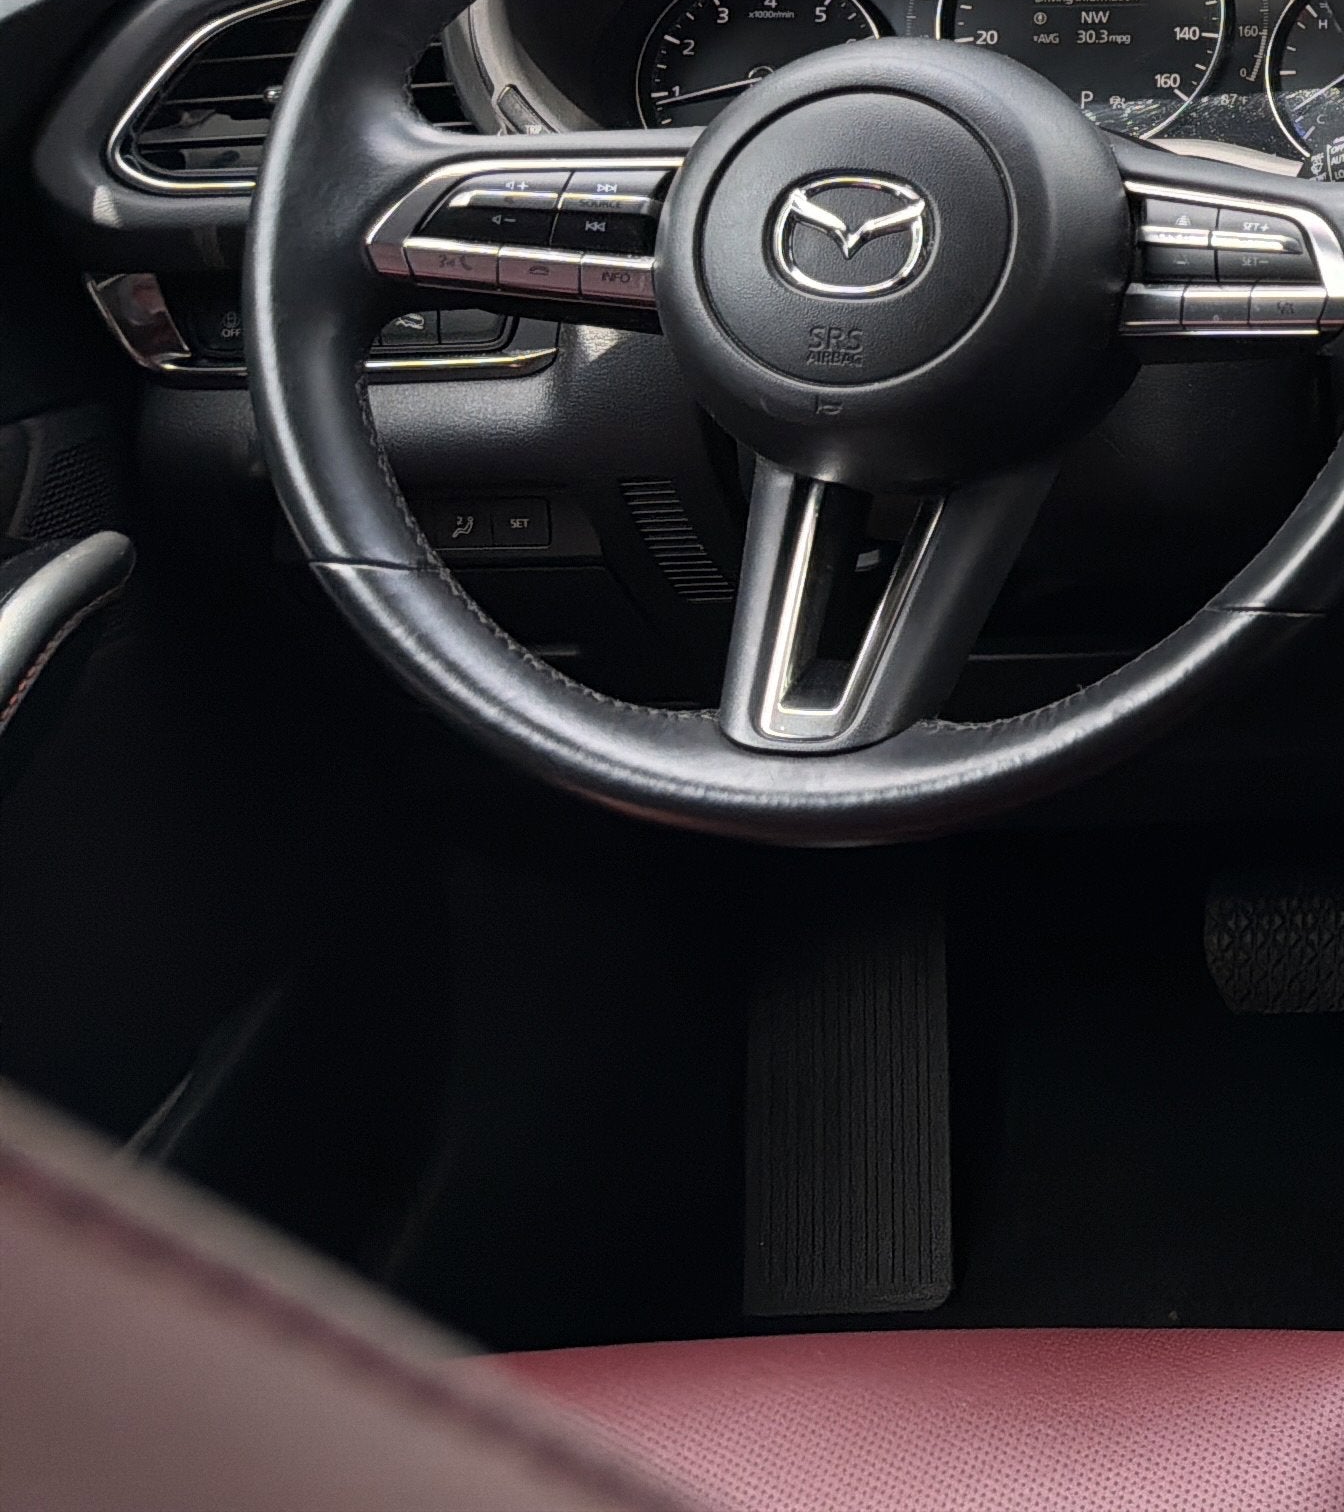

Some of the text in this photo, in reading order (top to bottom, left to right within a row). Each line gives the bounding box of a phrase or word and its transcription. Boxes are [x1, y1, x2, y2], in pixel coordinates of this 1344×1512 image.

[716, 8, 729, 24] 3
[814, 7, 827, 23] 5
[1081, 11, 1109, 23] NW
[1238, 25, 1258, 37] 160
[1318, 19, 1328, 30] H
[976, 31, 998, 45] 20
[1037, 30, 1130, 46] AVG 30.3 mpg
[1173, 26, 1200, 41] 140
[682, 39, 695, 56] 2
[1155, 73, 1180, 88] 160
[1081, 90, 1093, 109] P
[1334, 169, 1344, 180] LO
[601, 271, 631, 283] INFO
[808, 327, 863, 354] SRS
[806, 350, 864, 368] AIRBAG
[510, 518, 530, 529] SET
